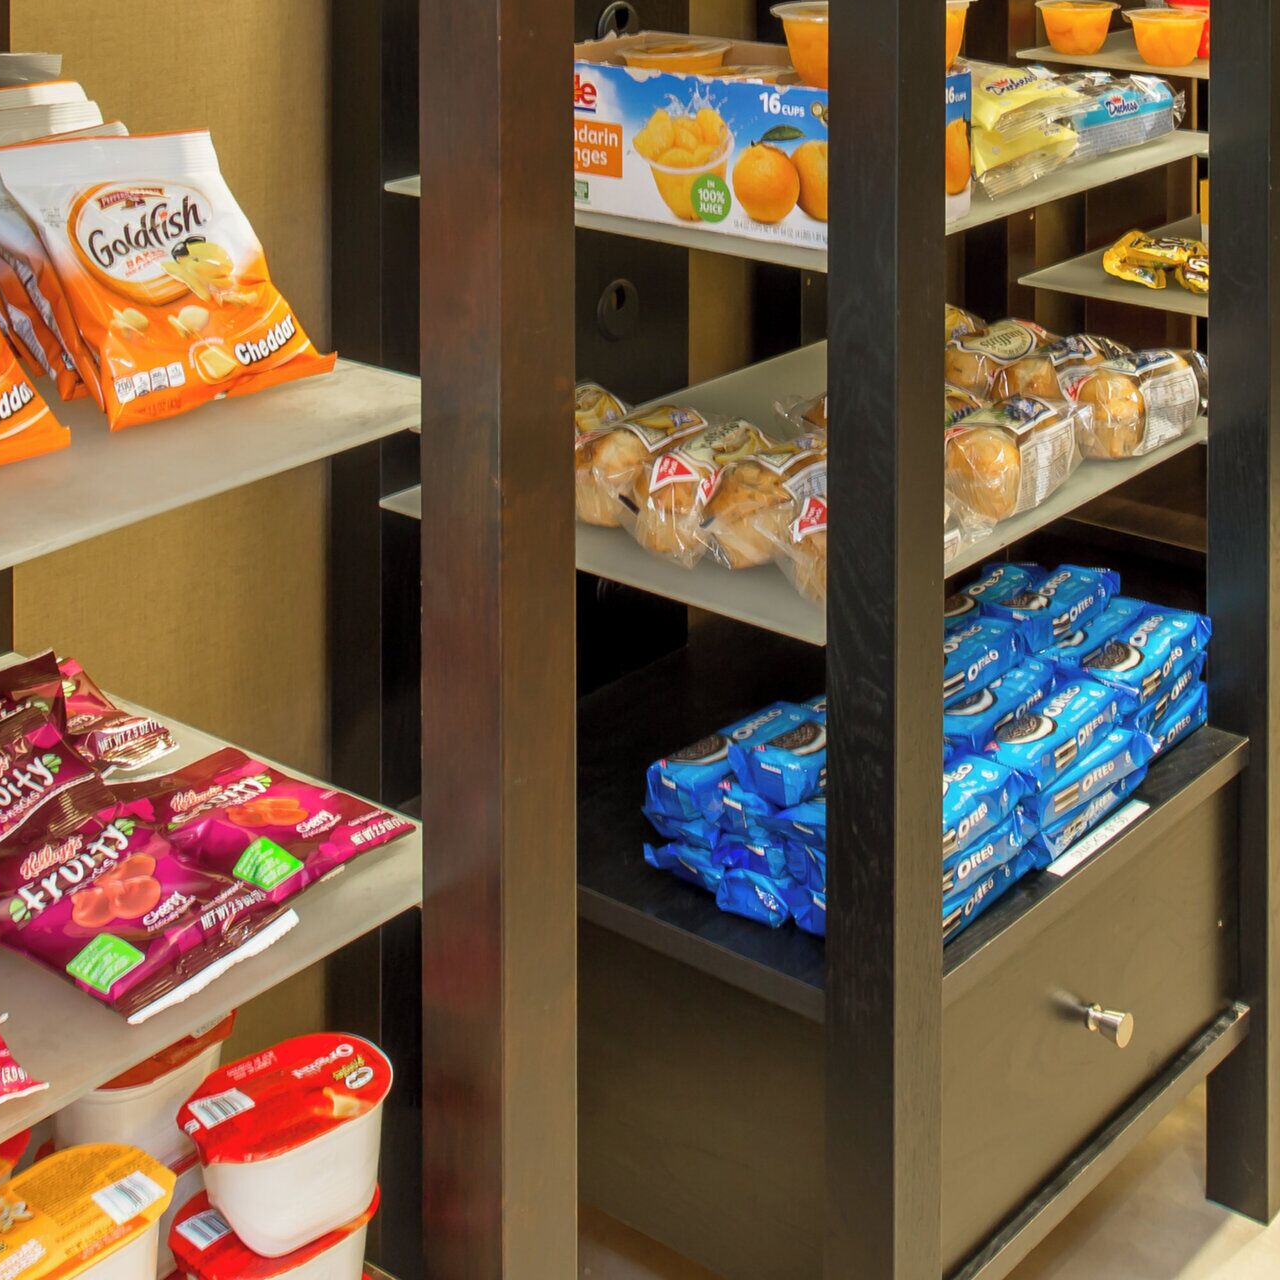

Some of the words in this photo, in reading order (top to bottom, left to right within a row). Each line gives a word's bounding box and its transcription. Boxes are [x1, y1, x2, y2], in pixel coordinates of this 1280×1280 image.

[758, 91, 782, 117] 16
[782, 103, 806, 119] CUPS
[1105, 99, 1139, 117] Duchess
[696, 186, 726, 206] 100%
[706, 179, 716, 188] IN
[697, 201, 724, 216] JUICE
[88, 195, 205, 270] Goldfish
[234, 313, 297, 367] Cheddar
[968, 568, 1006, 597] OREO
[1069, 595, 1094, 622] OREO
[1129, 614, 1164, 647] OREO
[966, 648, 999, 682] OREO
[1161, 646, 1184, 678] OREO
[1042, 685, 1081, 718] OREO
[1169, 669, 1194, 701] OREO
[1076, 714, 1105, 747] OREO
[1166, 714, 1192, 744] OREO
[1081, 760, 1115, 794] OREO
[957, 802, 989, 840] OREO
[17, 823, 130, 914] Fruity
[20, 834, 85, 880] Kellogg's
[956, 842, 994, 881] OREO
[964, 878, 995, 918] OREO
